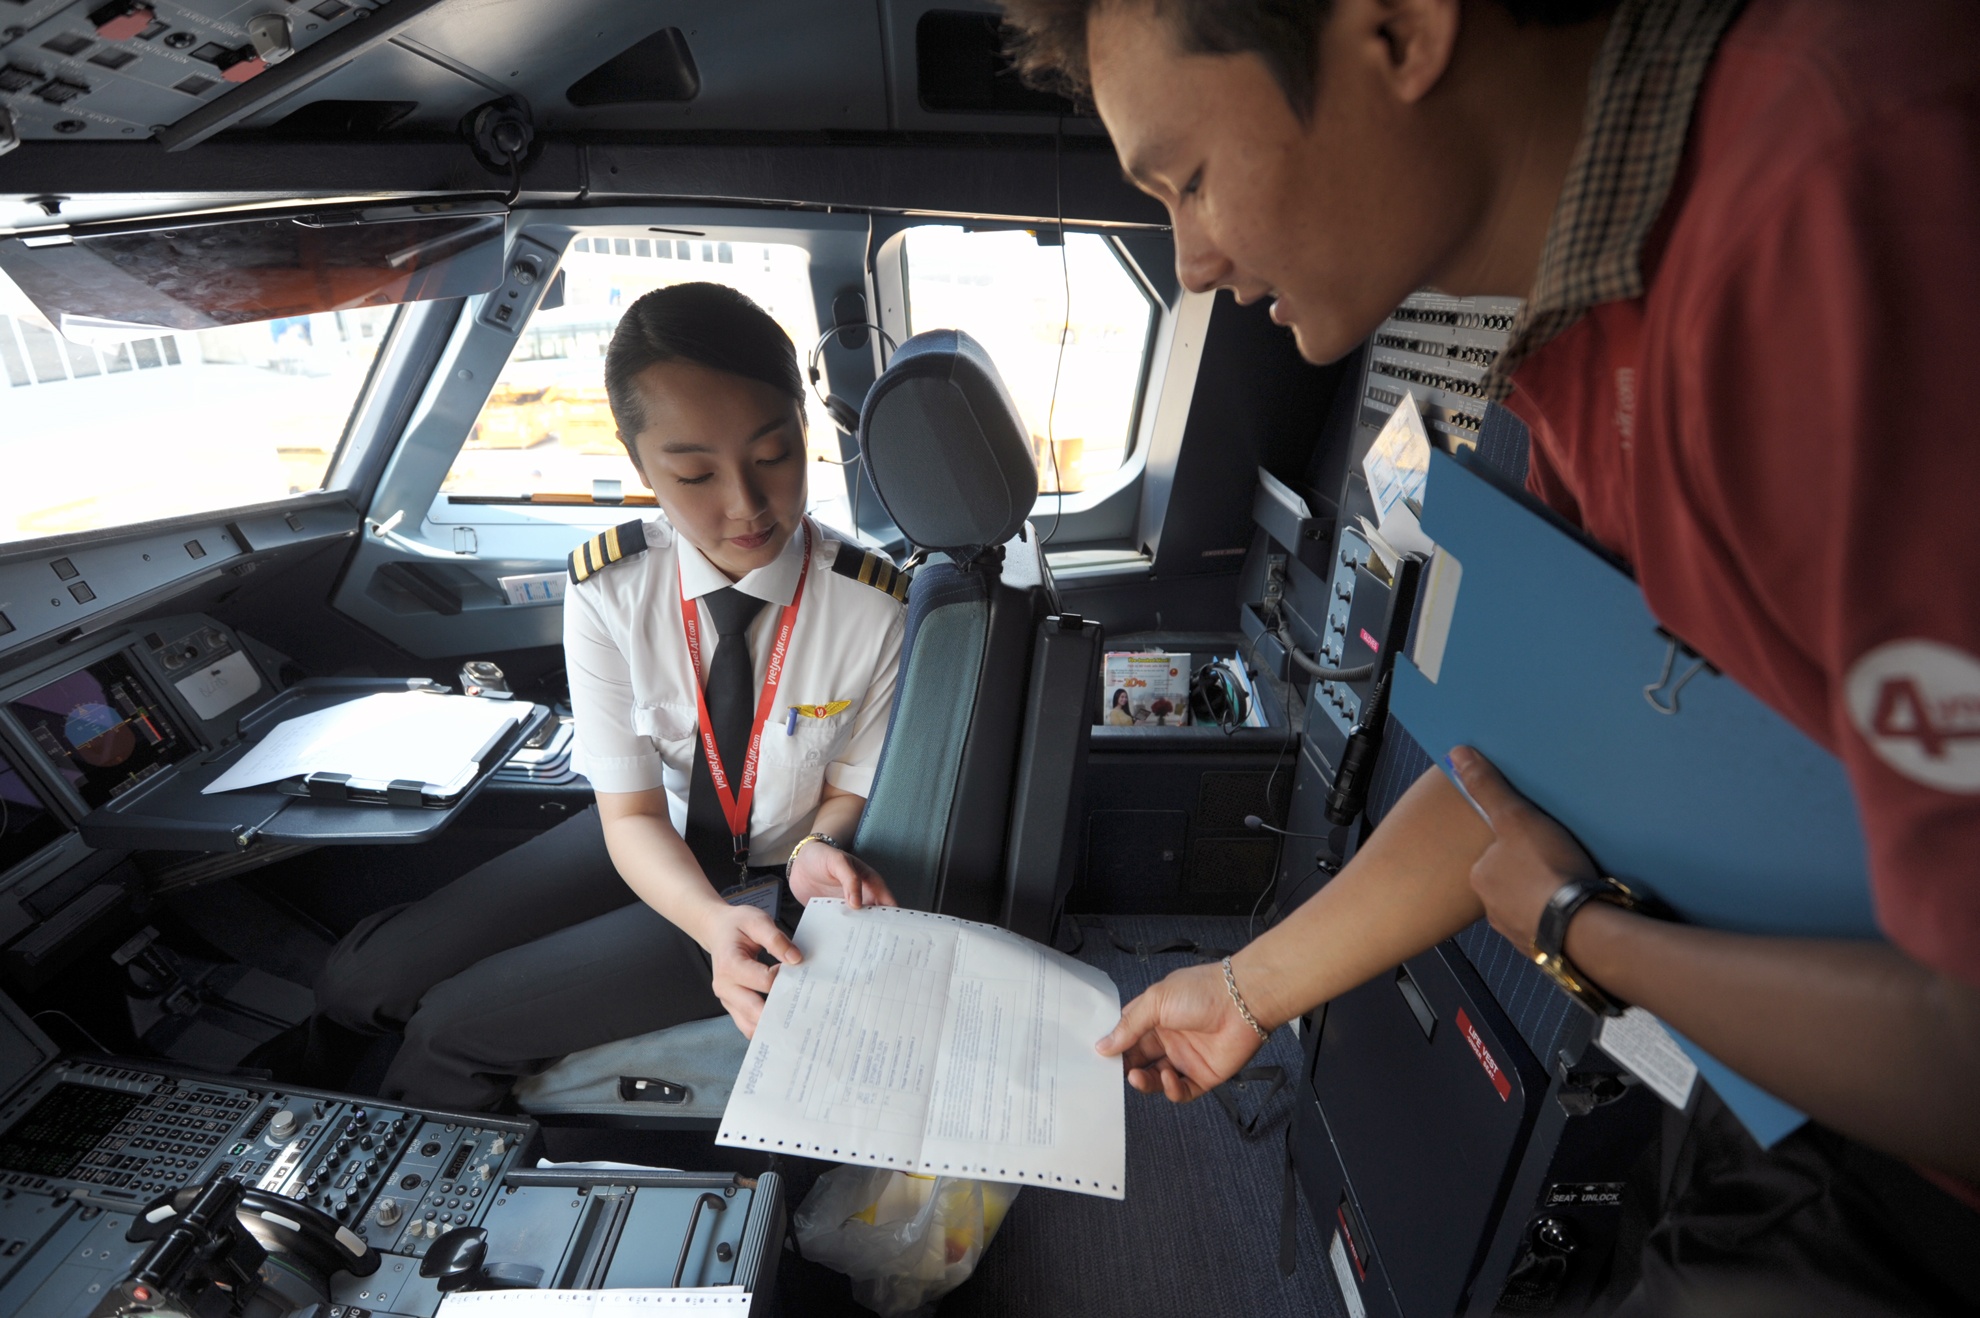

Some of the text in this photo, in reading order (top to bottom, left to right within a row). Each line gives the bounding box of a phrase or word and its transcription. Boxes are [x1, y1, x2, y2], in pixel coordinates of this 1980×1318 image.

[1468, 1024, 1499, 1074] LIFE VEST
[349, 1160, 360, 1174] RESET
[340, 1175, 351, 1189] VOICE
[1552, 1192, 1620, 1203] SEAT UNLOCK
